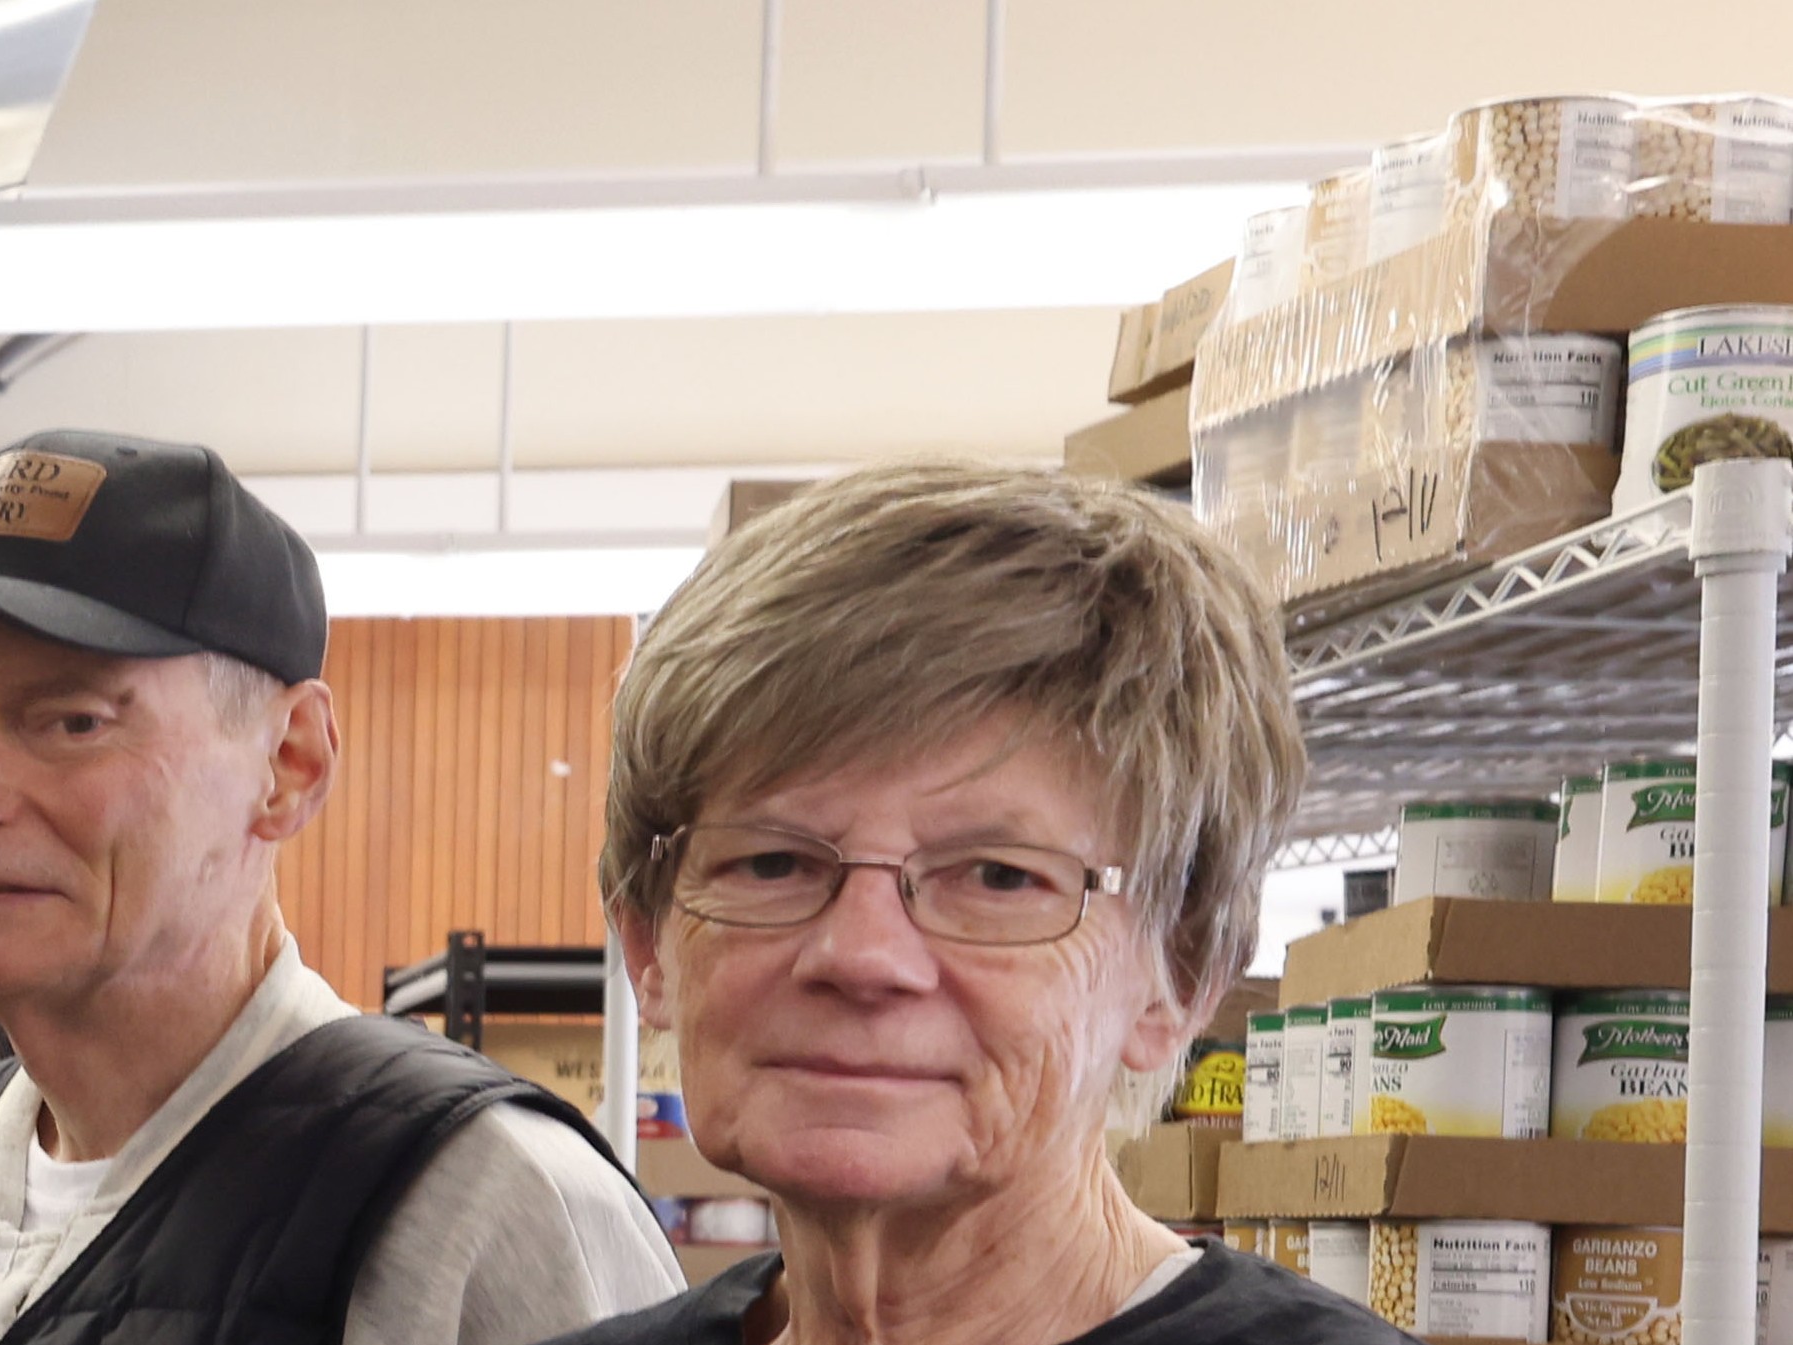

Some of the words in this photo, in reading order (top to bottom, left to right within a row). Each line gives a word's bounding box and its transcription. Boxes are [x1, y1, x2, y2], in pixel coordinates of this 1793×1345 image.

[1668, 375, 1709, 396] Cut
[1717, 371, 1784, 394] Green
[1609, 1063, 1689, 1079] Garba
[1371, 1076, 1402, 1092] ANS
[1621, 1080, 1689, 1096] BEAN
[1433, 1237, 1500, 1251] Nutrition
[1572, 1238, 1658, 1258] GARBANZO
[1585, 1258, 1638, 1275] BEANS
